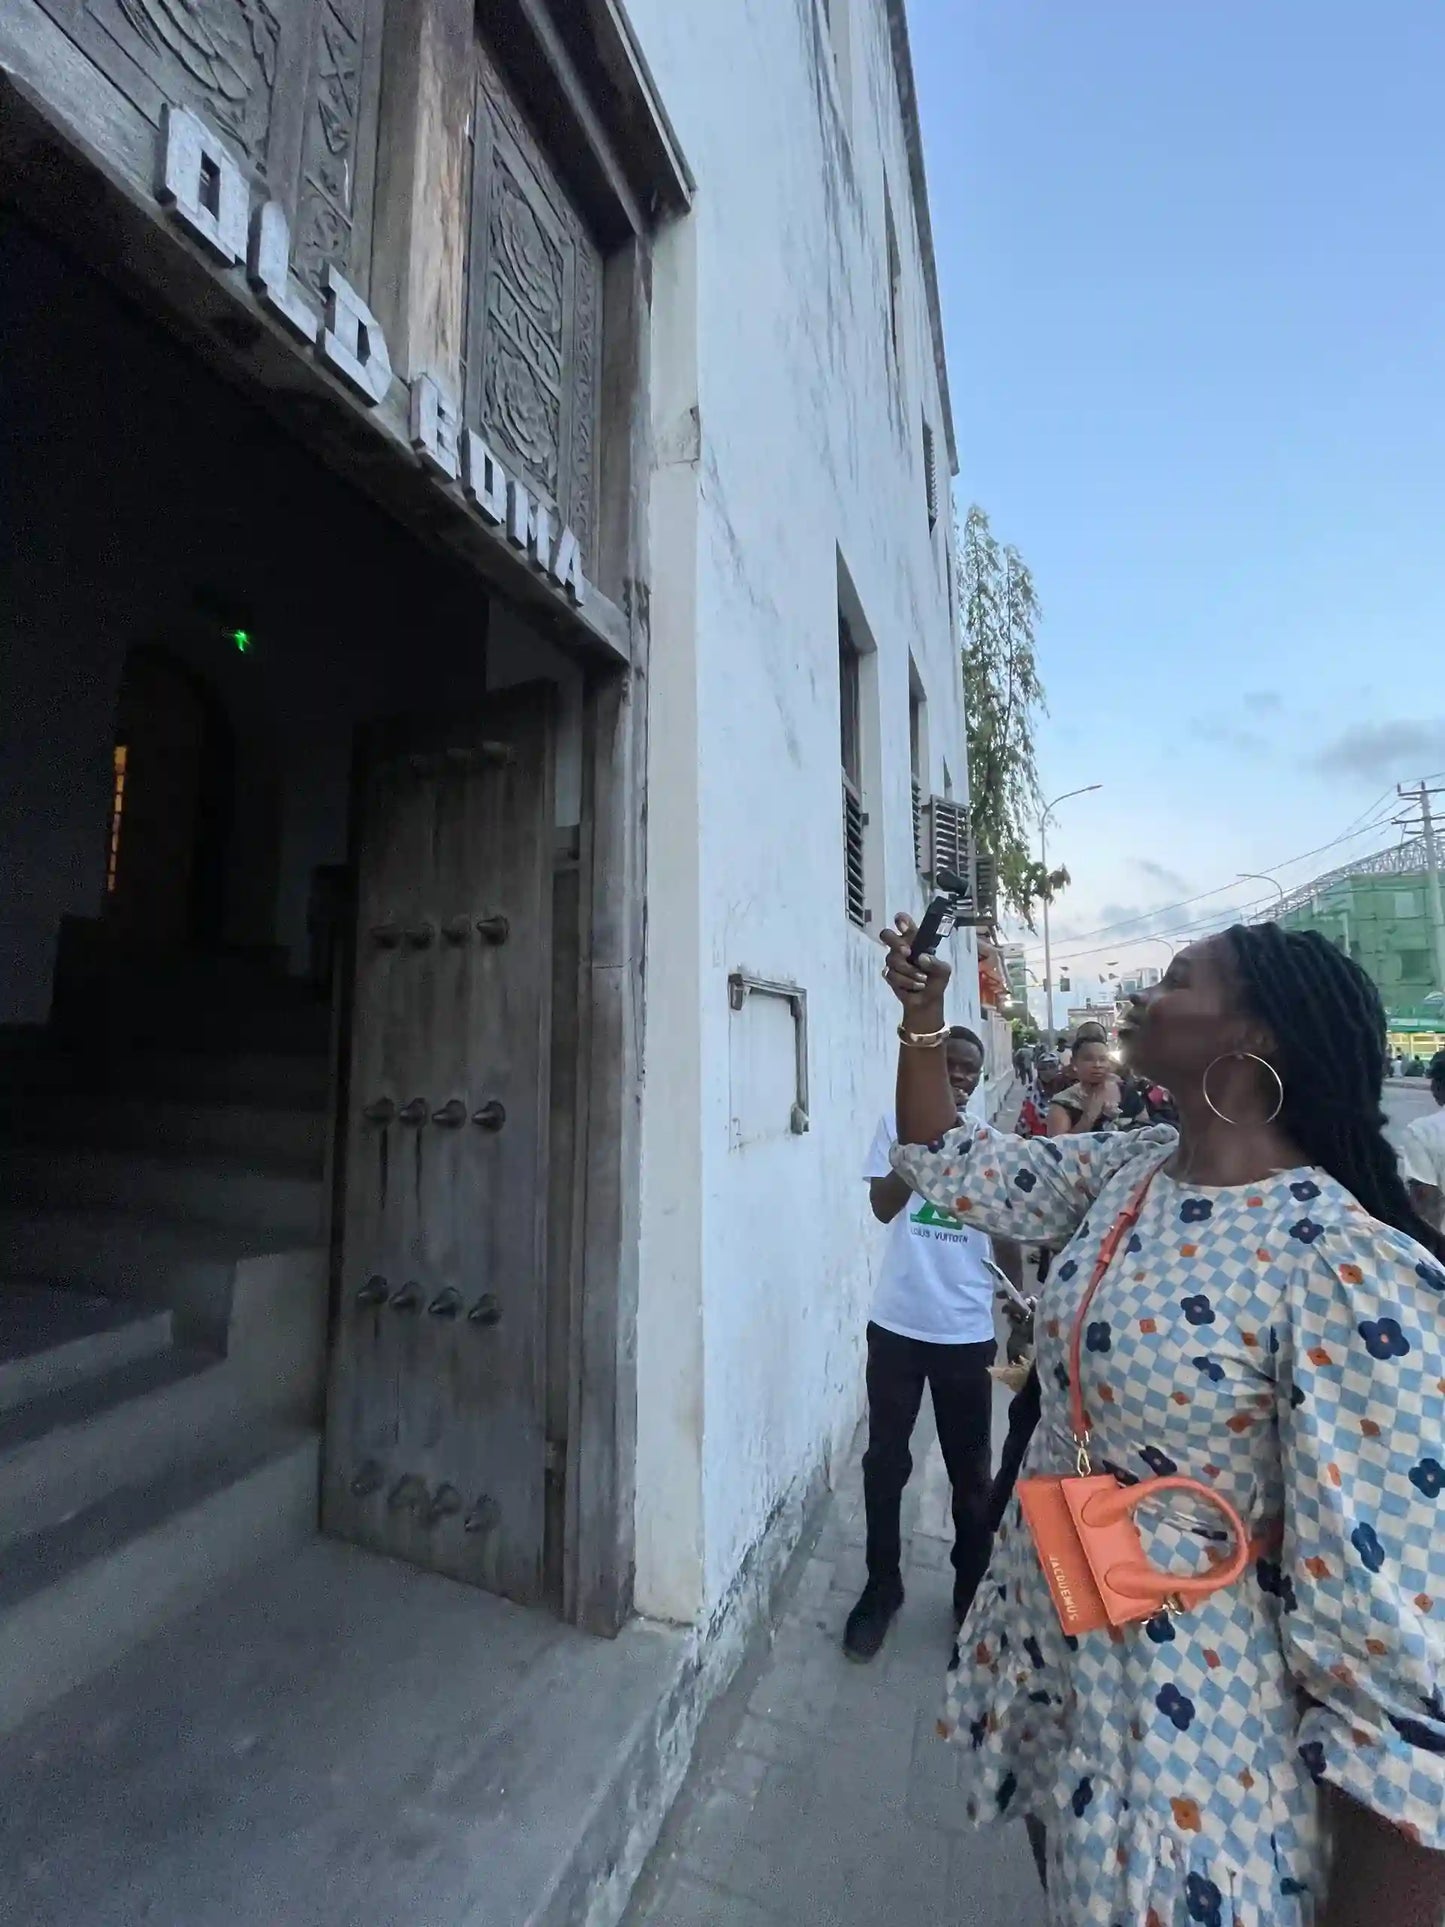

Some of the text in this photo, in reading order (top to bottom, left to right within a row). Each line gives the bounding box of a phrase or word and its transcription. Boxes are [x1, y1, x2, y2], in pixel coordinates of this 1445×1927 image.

[156, 103, 586, 606] OLD BOMA
[1049, 1554, 1079, 1621] JACQUEMUS
